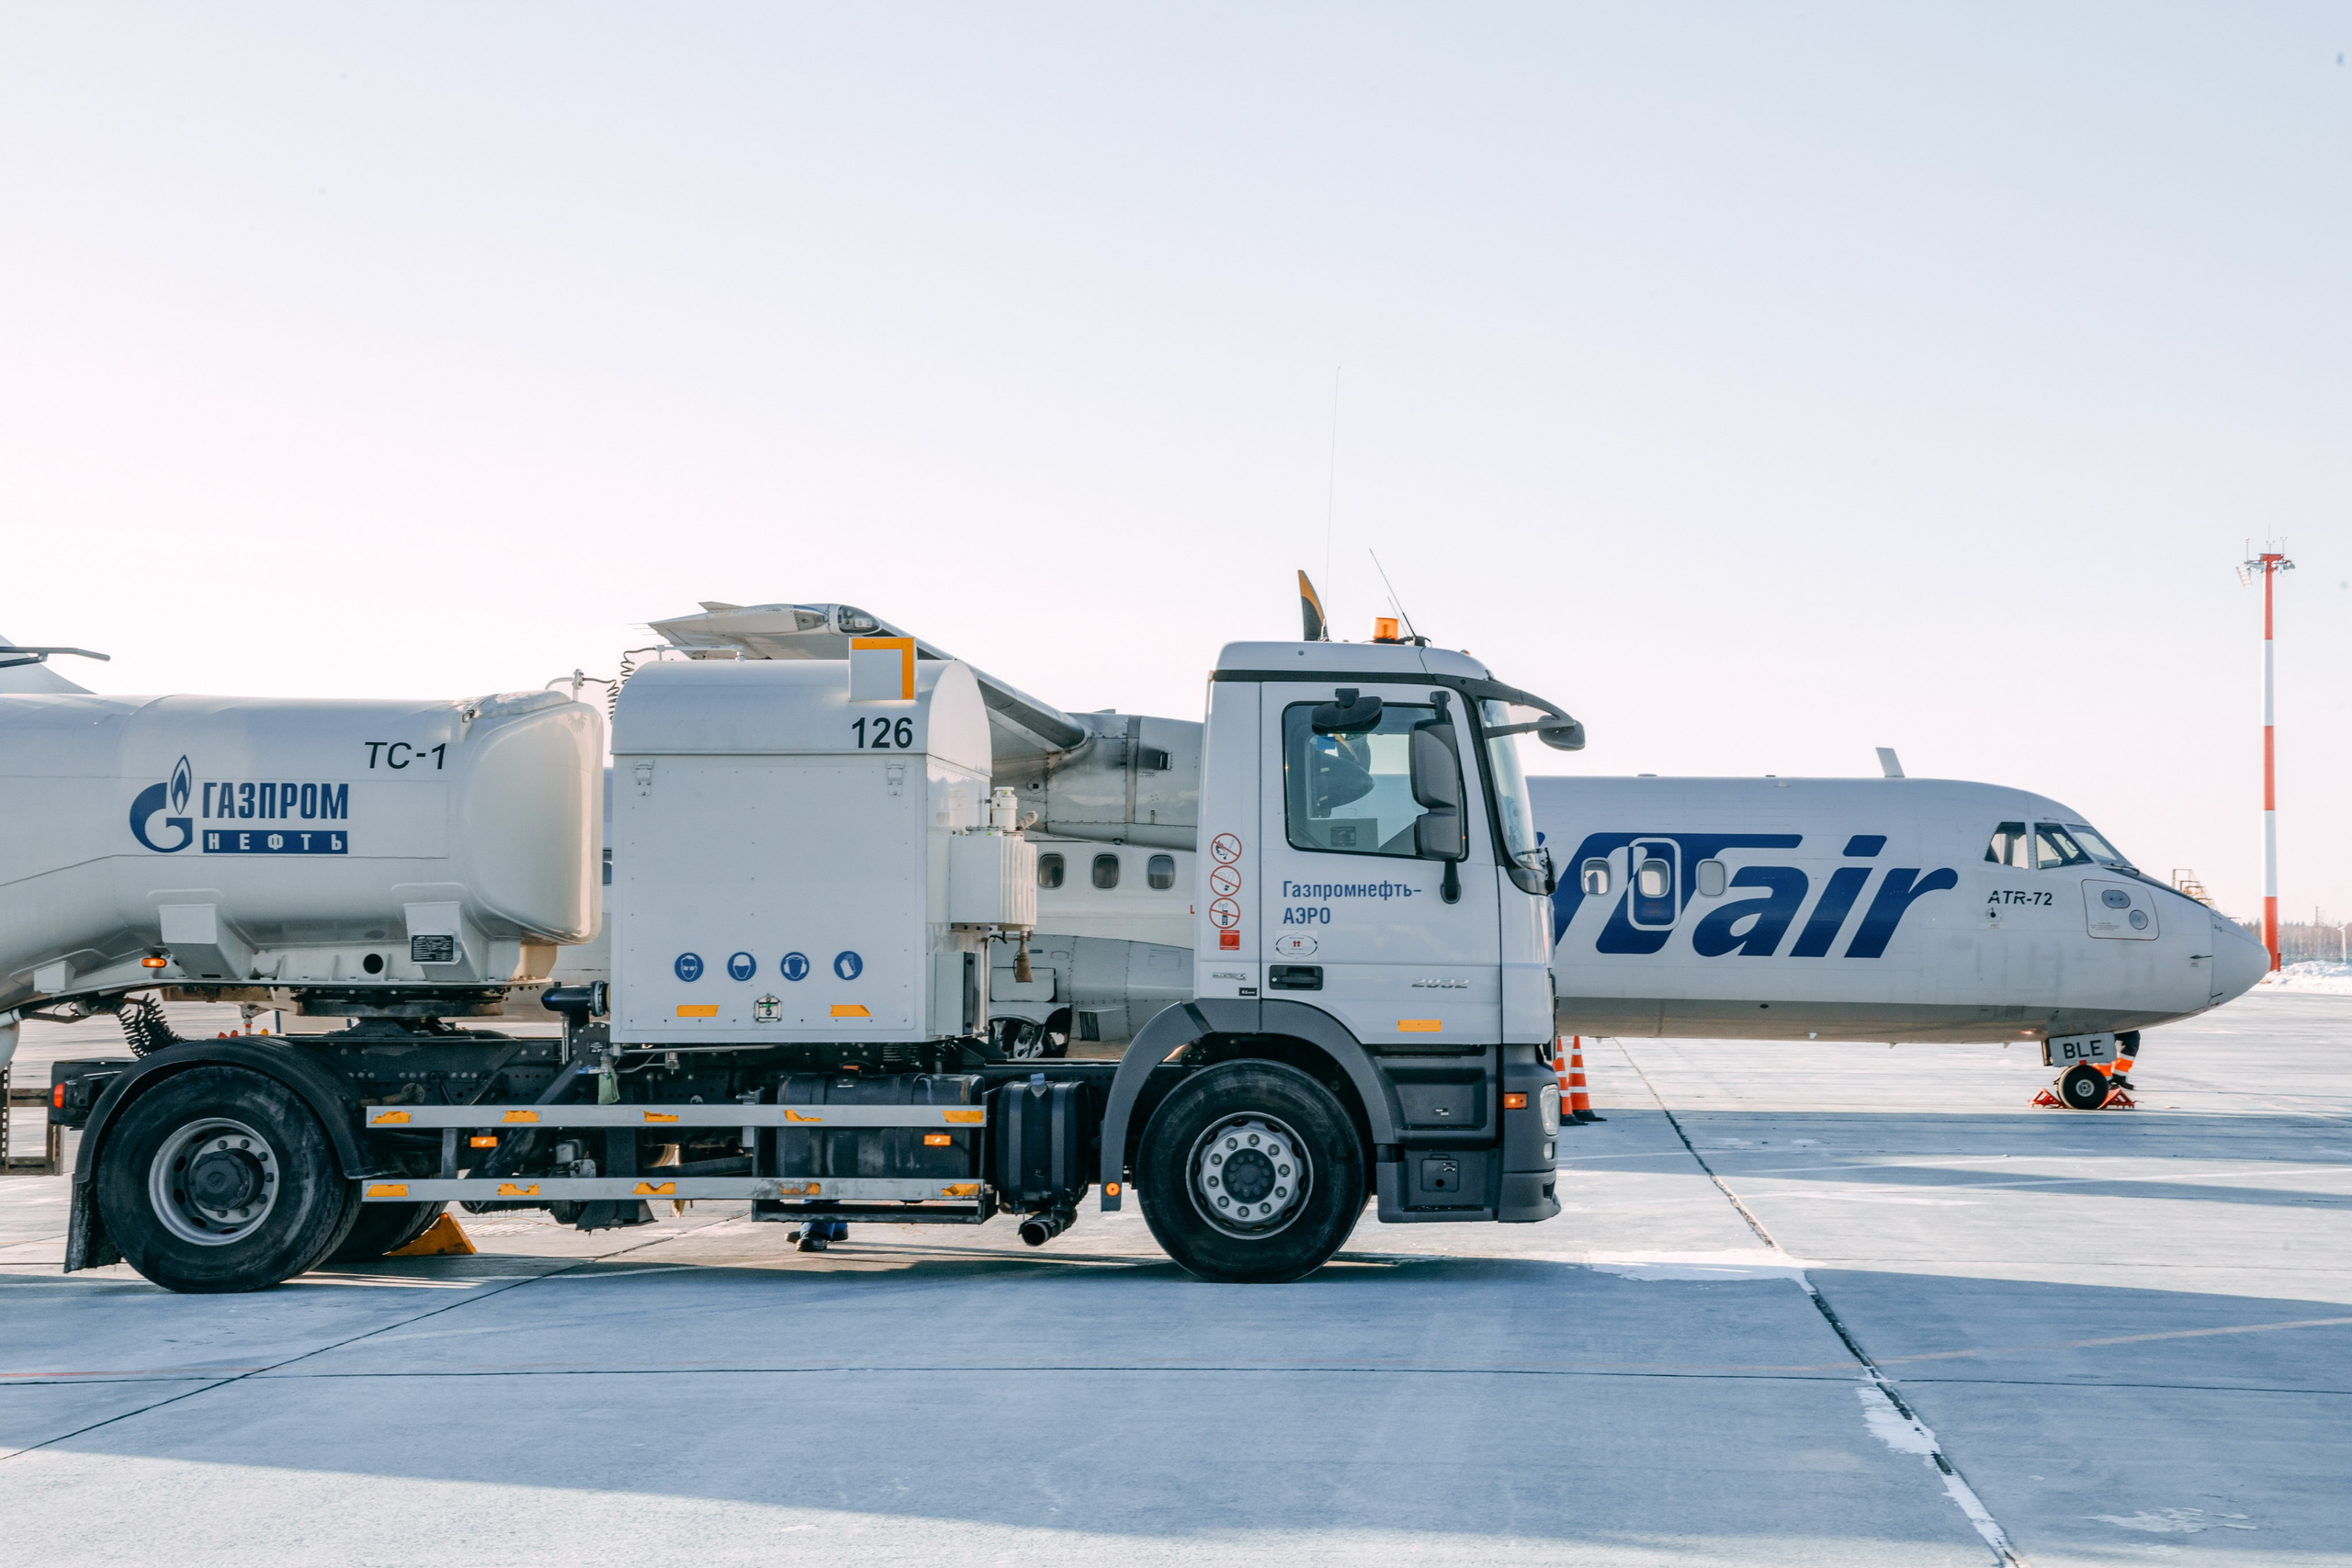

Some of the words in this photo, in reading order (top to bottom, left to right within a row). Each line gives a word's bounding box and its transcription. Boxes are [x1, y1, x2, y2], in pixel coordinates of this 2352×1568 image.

[852, 716, 913, 749] 126
[364, 741, 447, 770] ТС-1
[202, 782, 348, 819] ГАЗПРОМ
[208, 832, 343, 851] НЕФТЬ
[1283, 880, 1422, 901] Газпромнефть-
[1987, 890, 2052, 906] ATR-72
[1283, 907, 1331, 924] АЭРО
[1411, 977, 1470, 988] 2032
[2063, 1040, 2104, 1059] BLE
